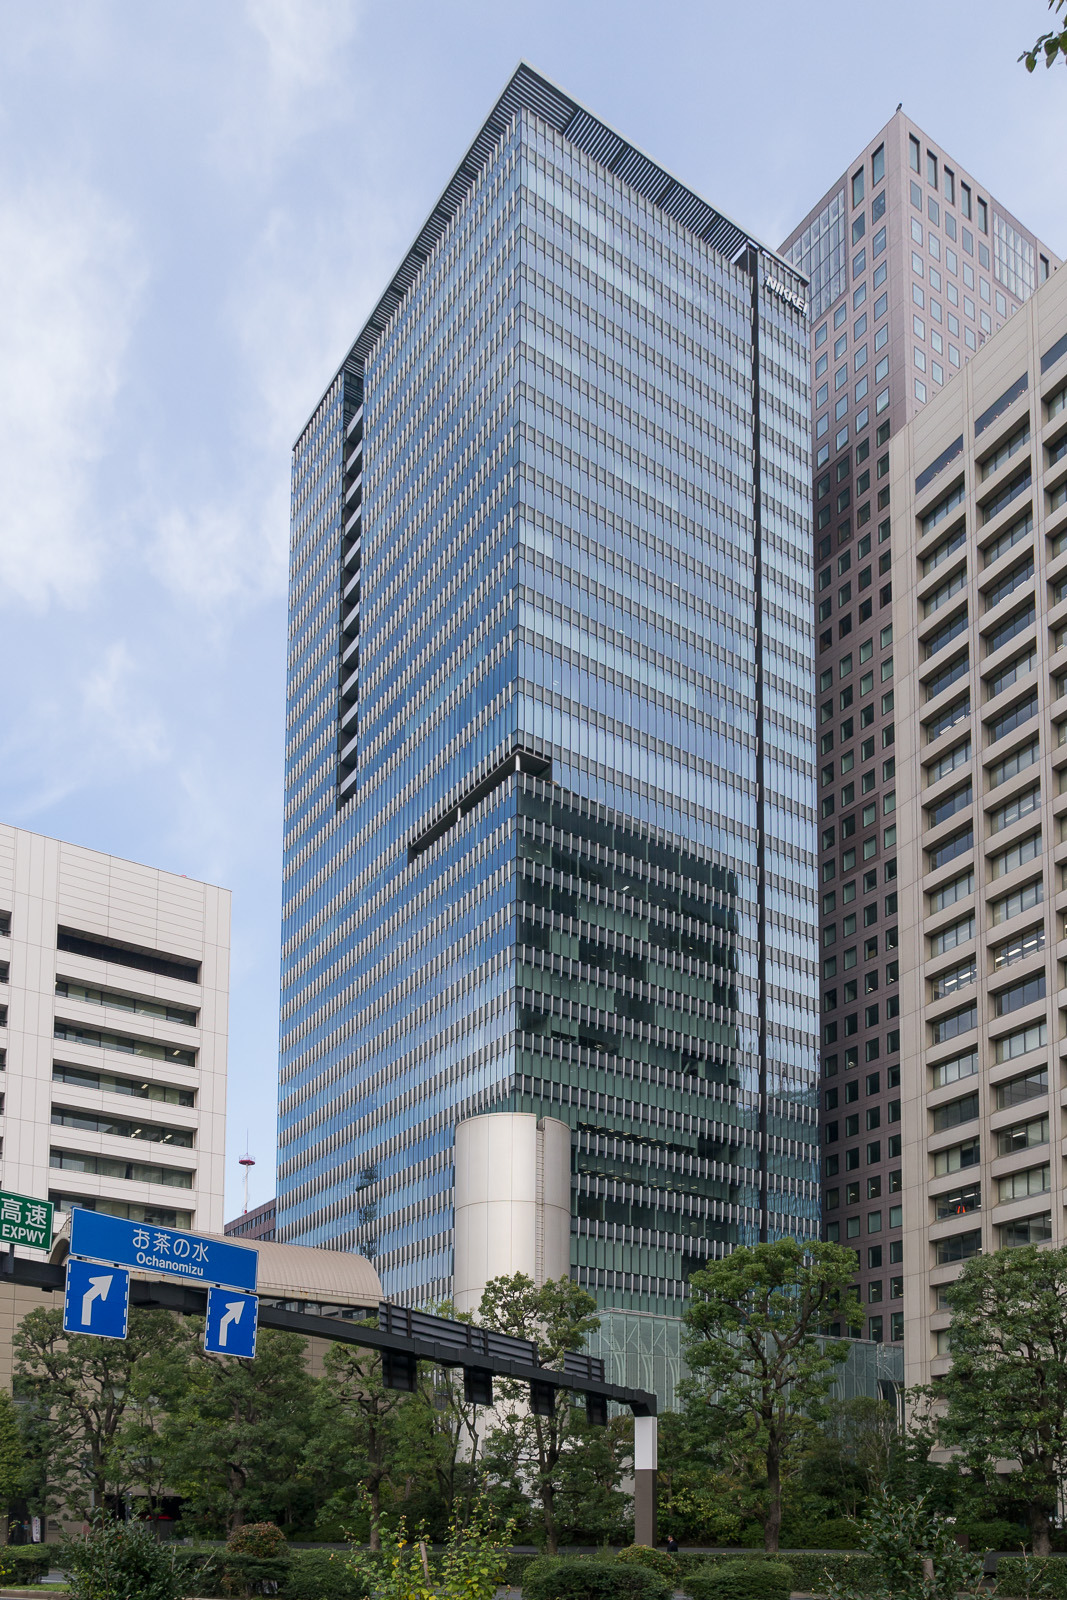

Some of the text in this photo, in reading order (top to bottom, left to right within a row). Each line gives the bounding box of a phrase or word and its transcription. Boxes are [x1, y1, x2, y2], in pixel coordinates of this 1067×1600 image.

[766, 276, 807, 313] NIKKEI
[1, 1198, 47, 1229] 高速
[2, 1224, 45, 1244] EXPWY
[132, 1228, 209, 1262] お茶の水
[136, 1252, 204, 1276] Ochanomizu
